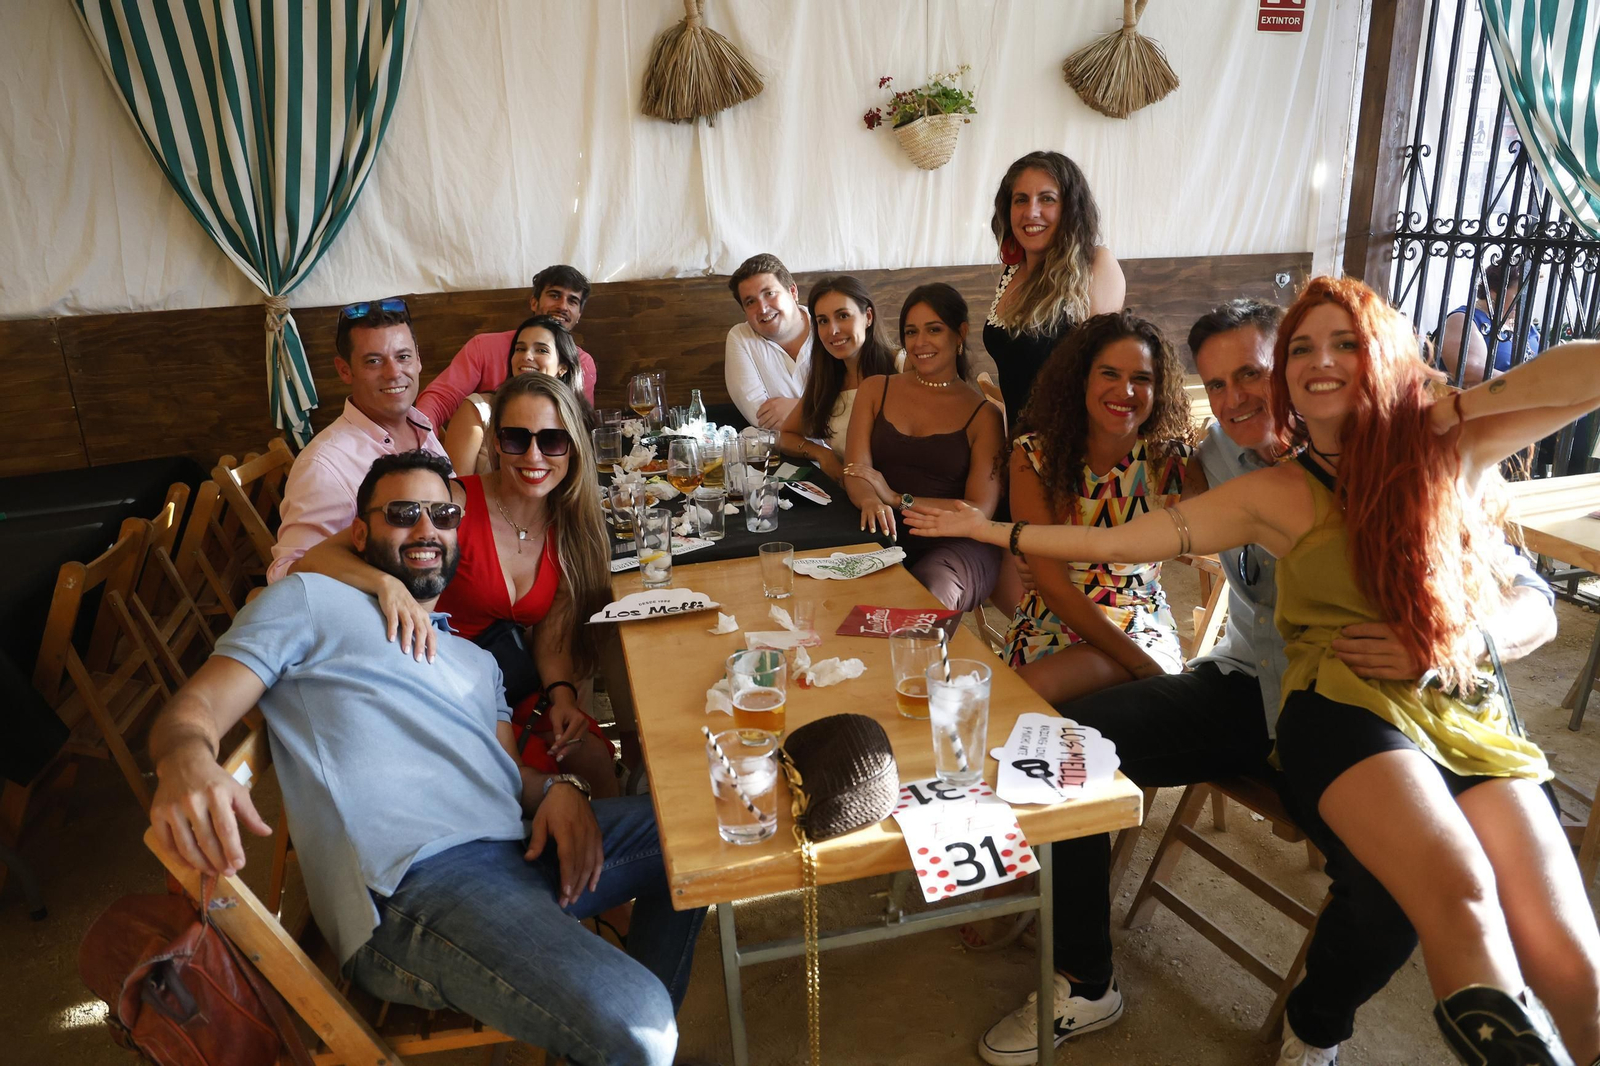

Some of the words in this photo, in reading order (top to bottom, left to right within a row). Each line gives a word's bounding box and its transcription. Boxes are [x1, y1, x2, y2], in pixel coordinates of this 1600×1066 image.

[1261, 16, 1300, 25] EXTINTOR
[605, 610, 641, 619] Los
[911, 613, 938, 634] 2025
[1060, 727, 1086, 749] LOS
[1057, 751, 1087, 789] MELLI
[907, 780, 966, 805] 31
[945, 836, 1008, 886] 31
